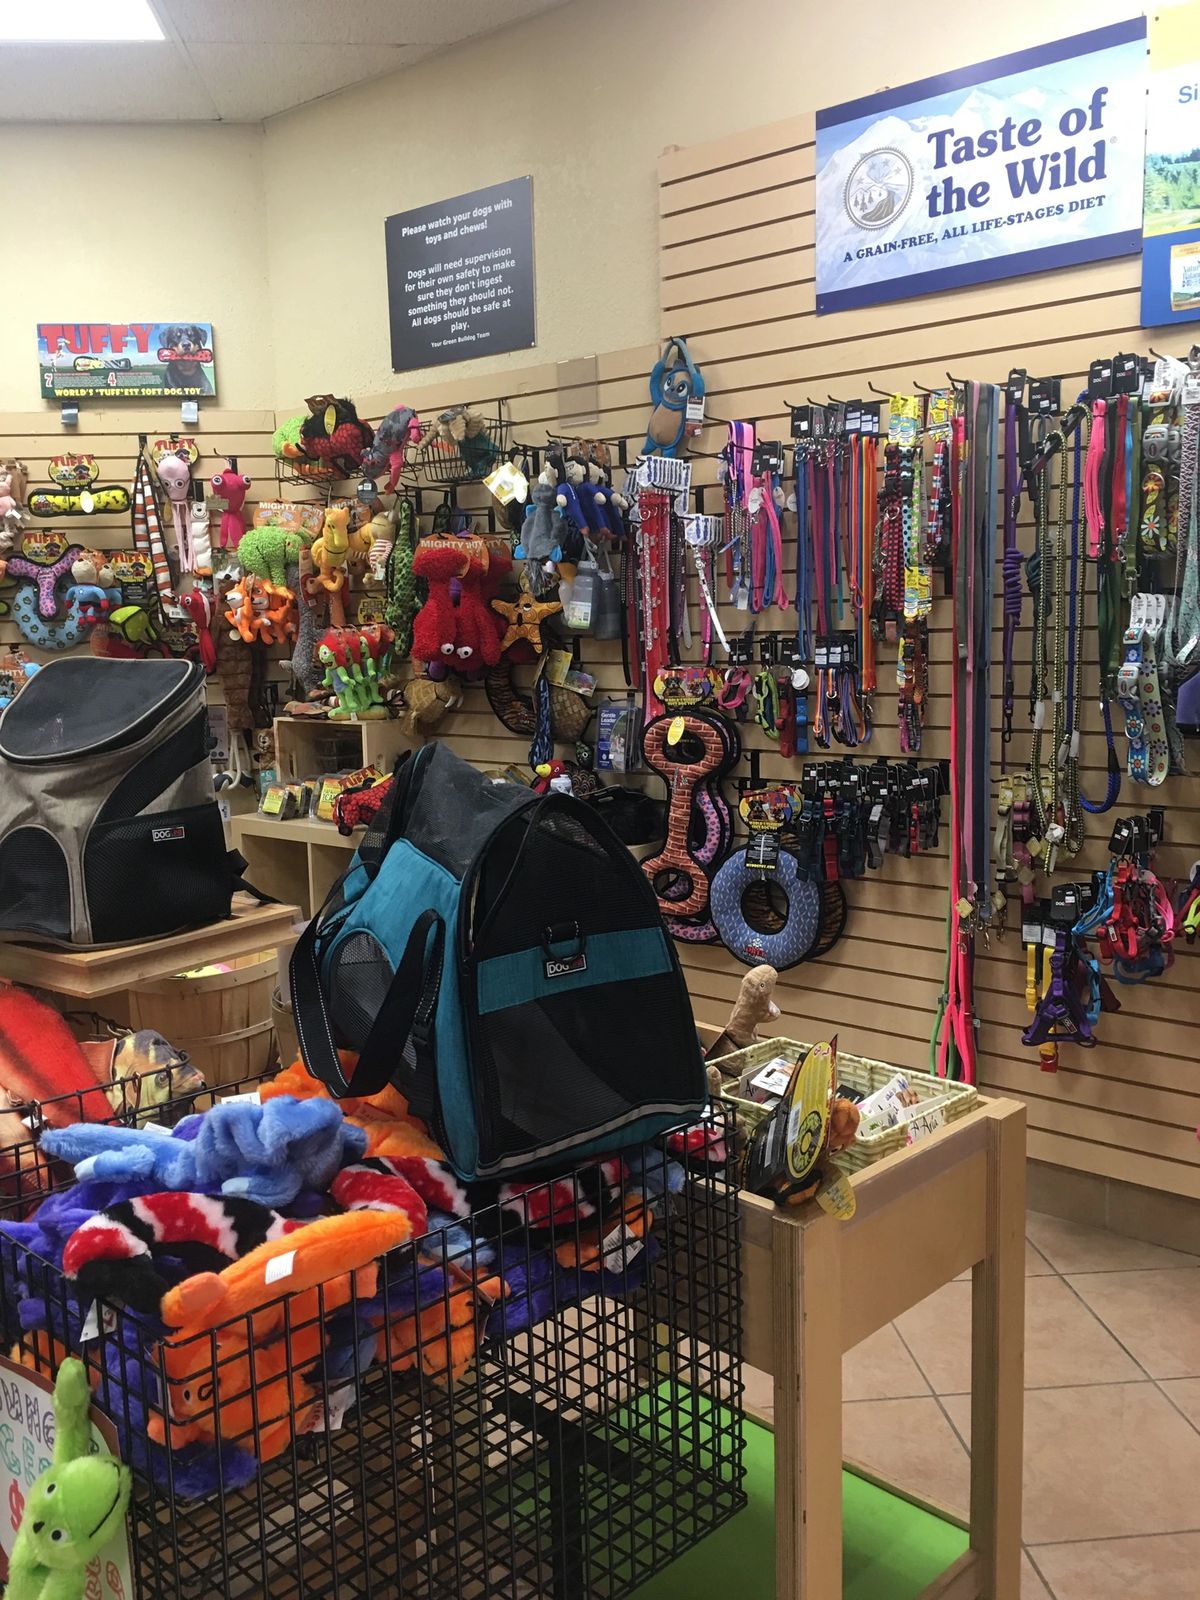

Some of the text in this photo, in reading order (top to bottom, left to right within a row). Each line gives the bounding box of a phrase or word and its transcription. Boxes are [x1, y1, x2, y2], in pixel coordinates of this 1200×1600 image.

[927, 86, 1109, 170] Taste of
[926, 139, 1107, 219] the Wild
[402, 198, 513, 238] Please watch your dogs with
[843, 195, 1107, 263] A GRAIN-FREE, ALL LIFE-STAGES DIET
[425, 219, 488, 245] toys and chews!
[405, 258, 516, 293] for their own safety to make
[407, 246, 512, 281] Dogs will need supervision
[407, 286, 515, 317] something they should not.
[417, 275, 503, 302] sure they don't ingest
[411, 298, 511, 328] All dogs should be safe at
[40, 323, 155, 354] TUFFY
[450, 320, 470, 334] play.
[54, 388, 94, 397] WORLD'S
[141, 388, 162, 396] SOFT
[164, 387, 183, 396] DOG
[184, 387, 201, 396] TOY
[107, 372, 117, 387] 4
[154, 438, 195, 451] TUFFY
[49, 454, 96, 467] TUFFY
[259, 501, 297, 511] MIGHTY
[24, 533, 66, 545] TUFFY
[420, 540, 464, 549] MIGHTY
[111, 551, 149, 564] TUFFY
